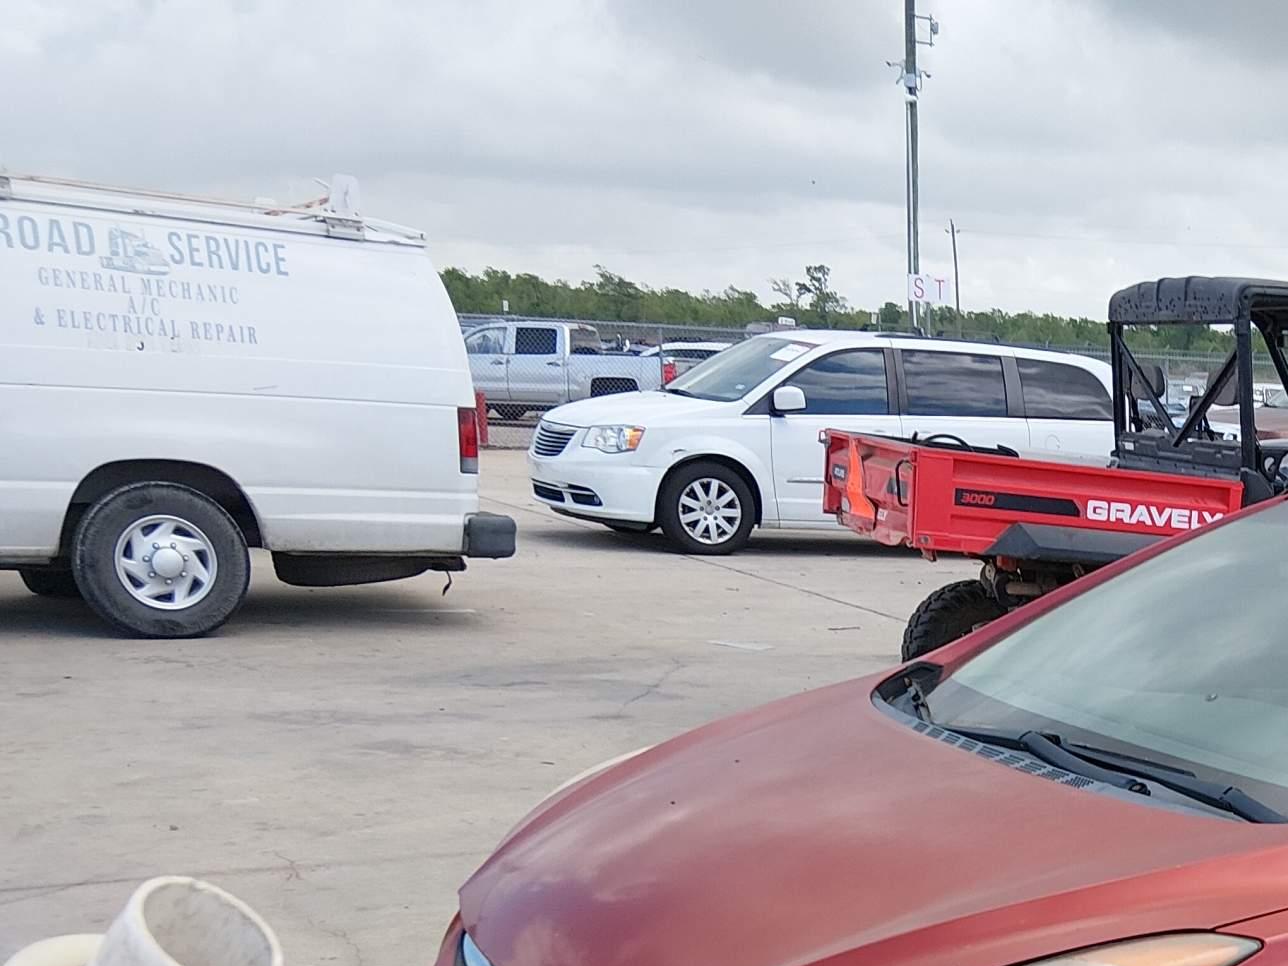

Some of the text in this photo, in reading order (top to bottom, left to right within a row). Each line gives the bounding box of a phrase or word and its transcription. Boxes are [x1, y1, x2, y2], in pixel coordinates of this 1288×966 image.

[0, 212, 289, 276] ROAD SERVICE
[38, 266, 239, 304] GENERAL MECHANIC
[913, 277, 945, 300] S T
[33, 306, 258, 345] & ELECTRICAL REPAIR
[128, 296, 161, 317] A/C
[960, 492, 1226, 530] 3000 GRAVELY
